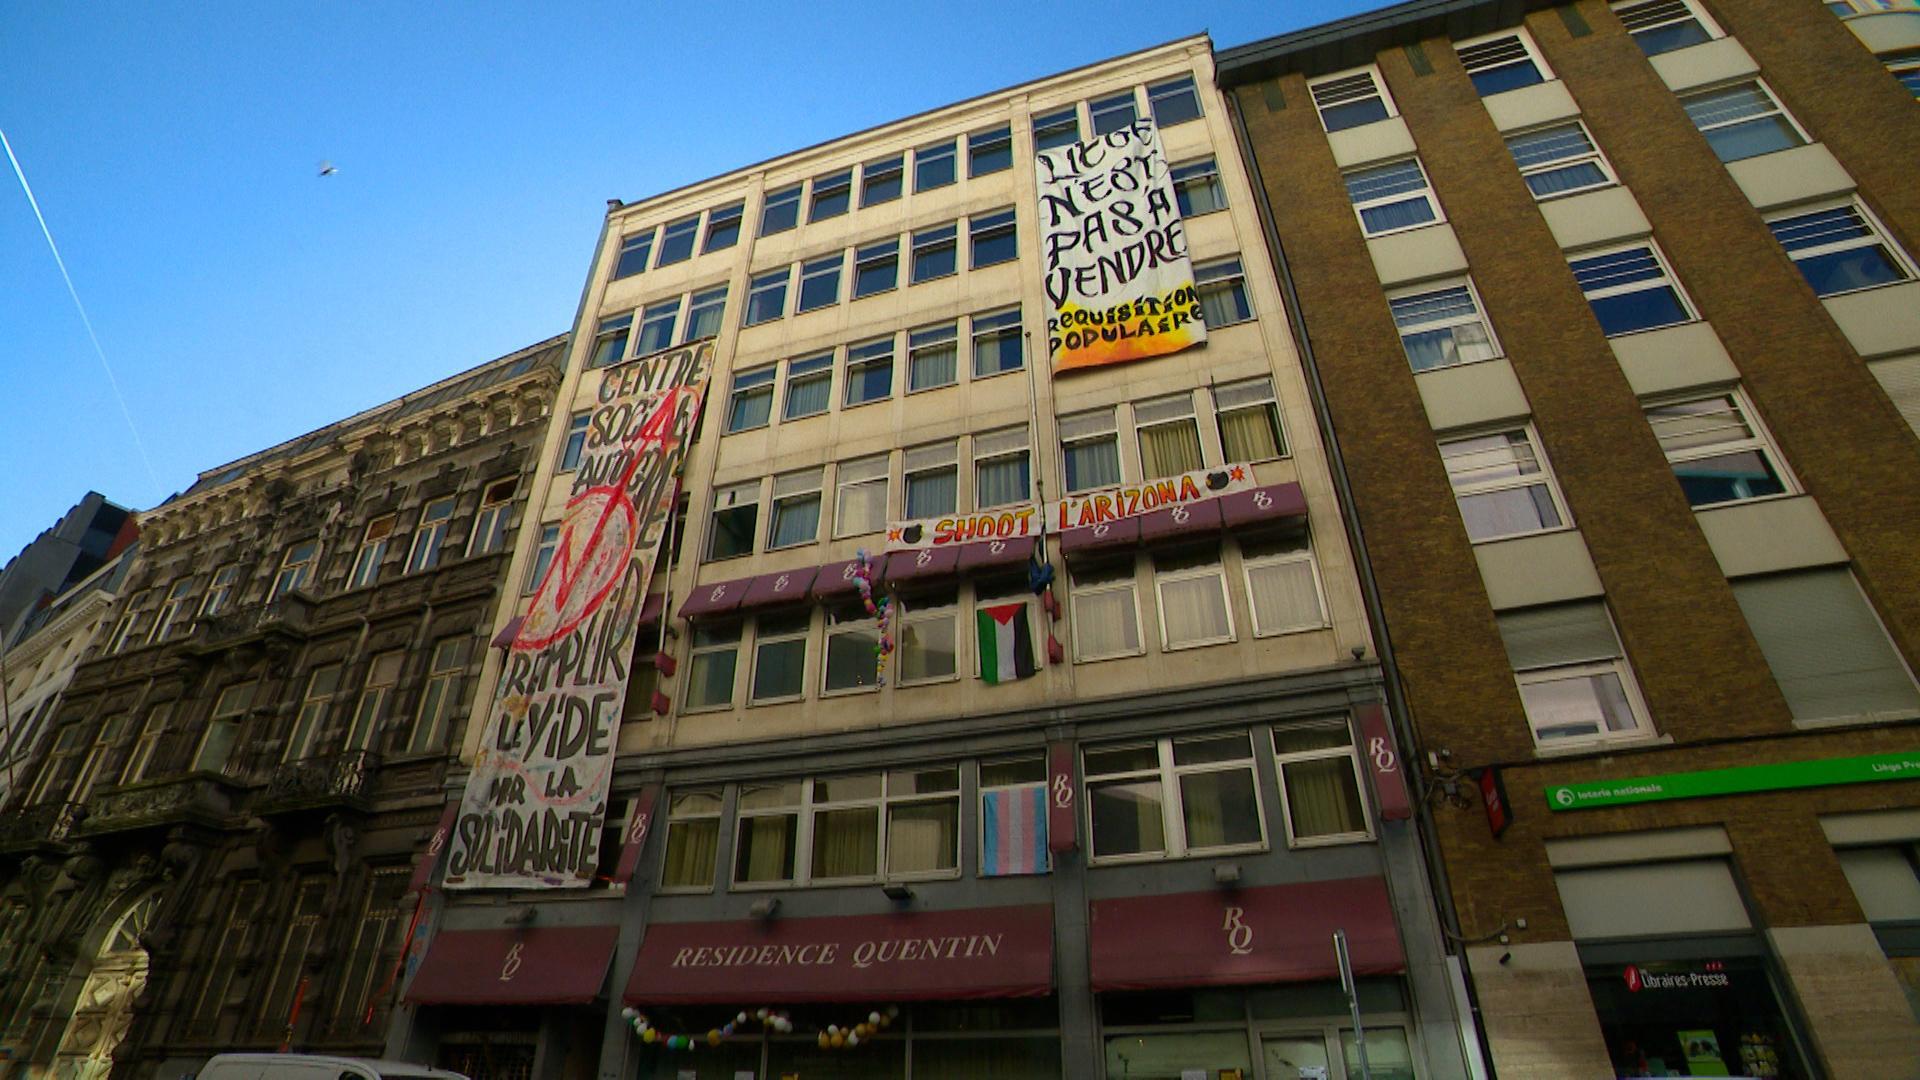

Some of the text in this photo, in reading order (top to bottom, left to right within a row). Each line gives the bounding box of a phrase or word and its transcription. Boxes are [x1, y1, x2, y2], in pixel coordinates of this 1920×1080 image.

[1040, 150, 1158, 226] N'EST
[1045, 218, 1188, 310] VENDRE
[1046, 200, 1143, 271] PAS
[598, 342, 711, 403] CENTRE
[933, 475, 1201, 544] SHOOT L'ARIZONA
[522, 692, 617, 762] VIDE
[544, 766, 582, 798] LA
[450, 801, 605, 876] SOLIDARITÉ
[671, 933, 1003, 968] RESIDENCE QUENTIN
[1223, 907, 1253, 954] RQ
